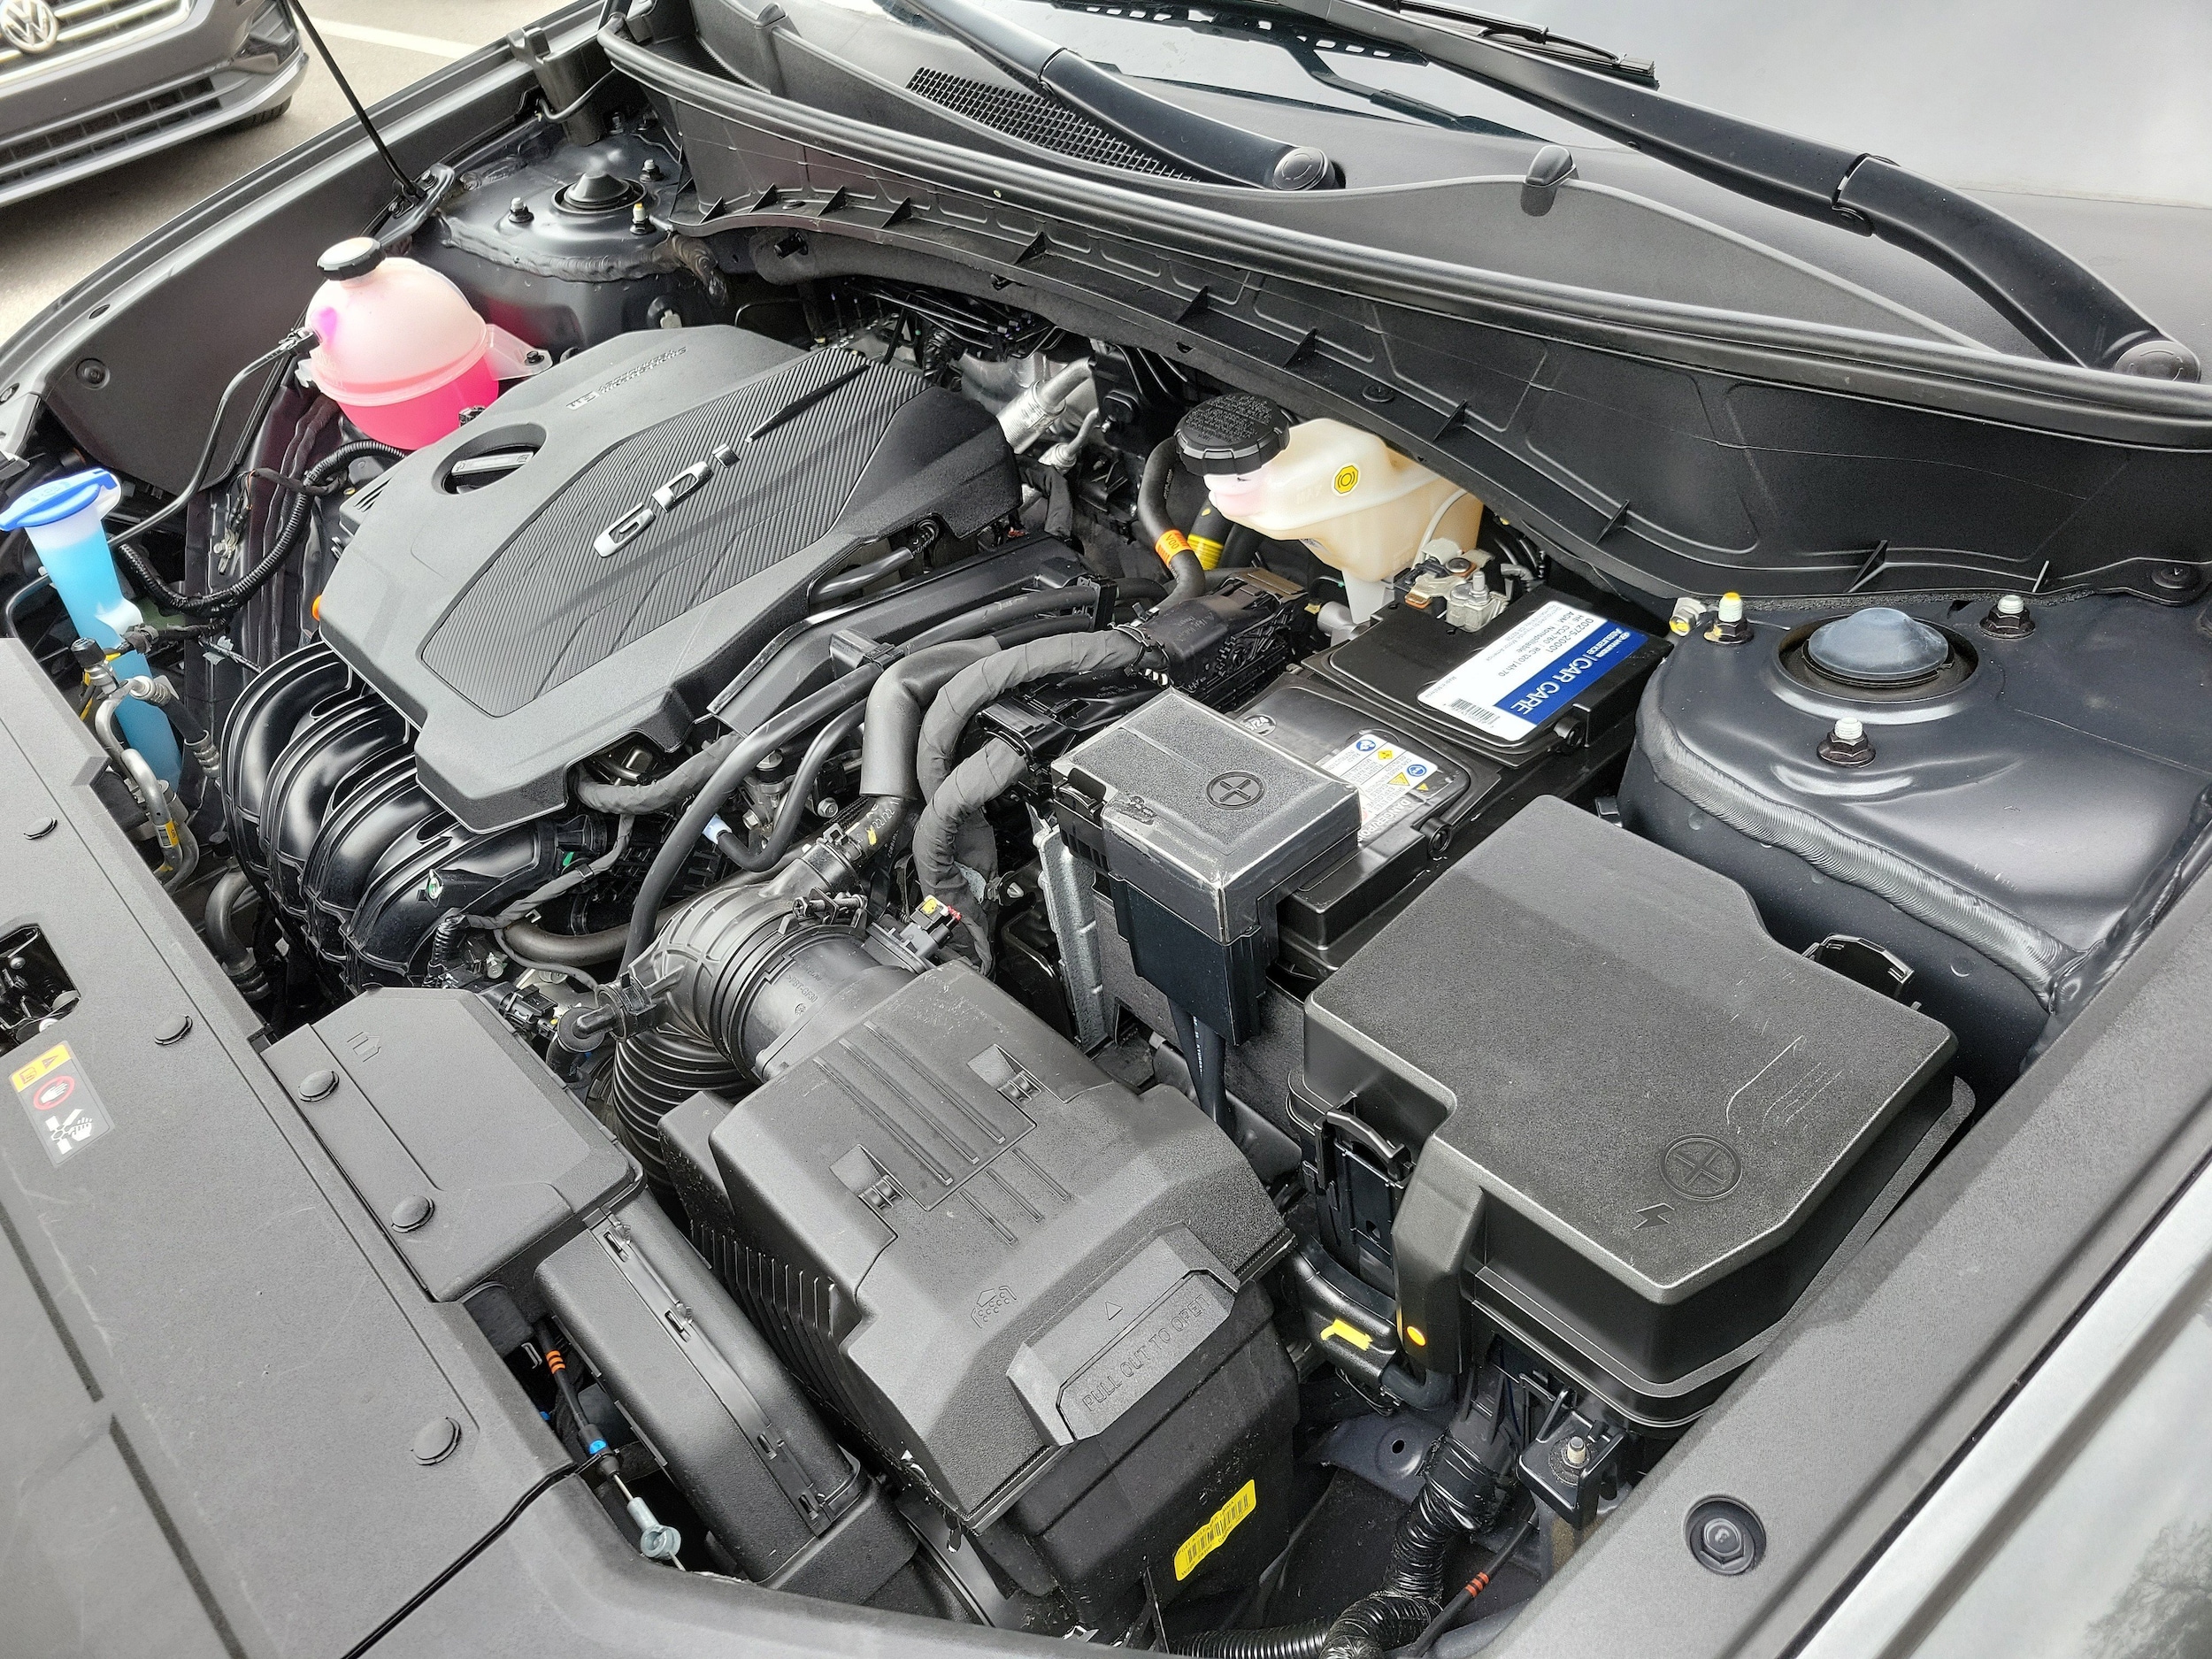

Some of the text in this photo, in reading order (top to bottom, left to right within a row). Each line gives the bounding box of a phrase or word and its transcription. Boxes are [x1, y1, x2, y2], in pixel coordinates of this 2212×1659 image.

[1515, 611, 1575, 654] AGM Nonspillable
[1541, 634, 1557, 644] 760
[1544, 617, 1594, 653] 00275-20001
[1553, 625, 1570, 635] CCA
[1584, 627, 1624, 656] Assurance
[1517, 652, 1532, 662] 120
[1527, 646, 1540, 655] RC
[1504, 663, 1518, 672] Ah
[1550, 656, 1594, 684] CAR
[1508, 679, 1563, 716] CARE
[1081, 1294, 1211, 1412] PULL OUT TO OPEN
